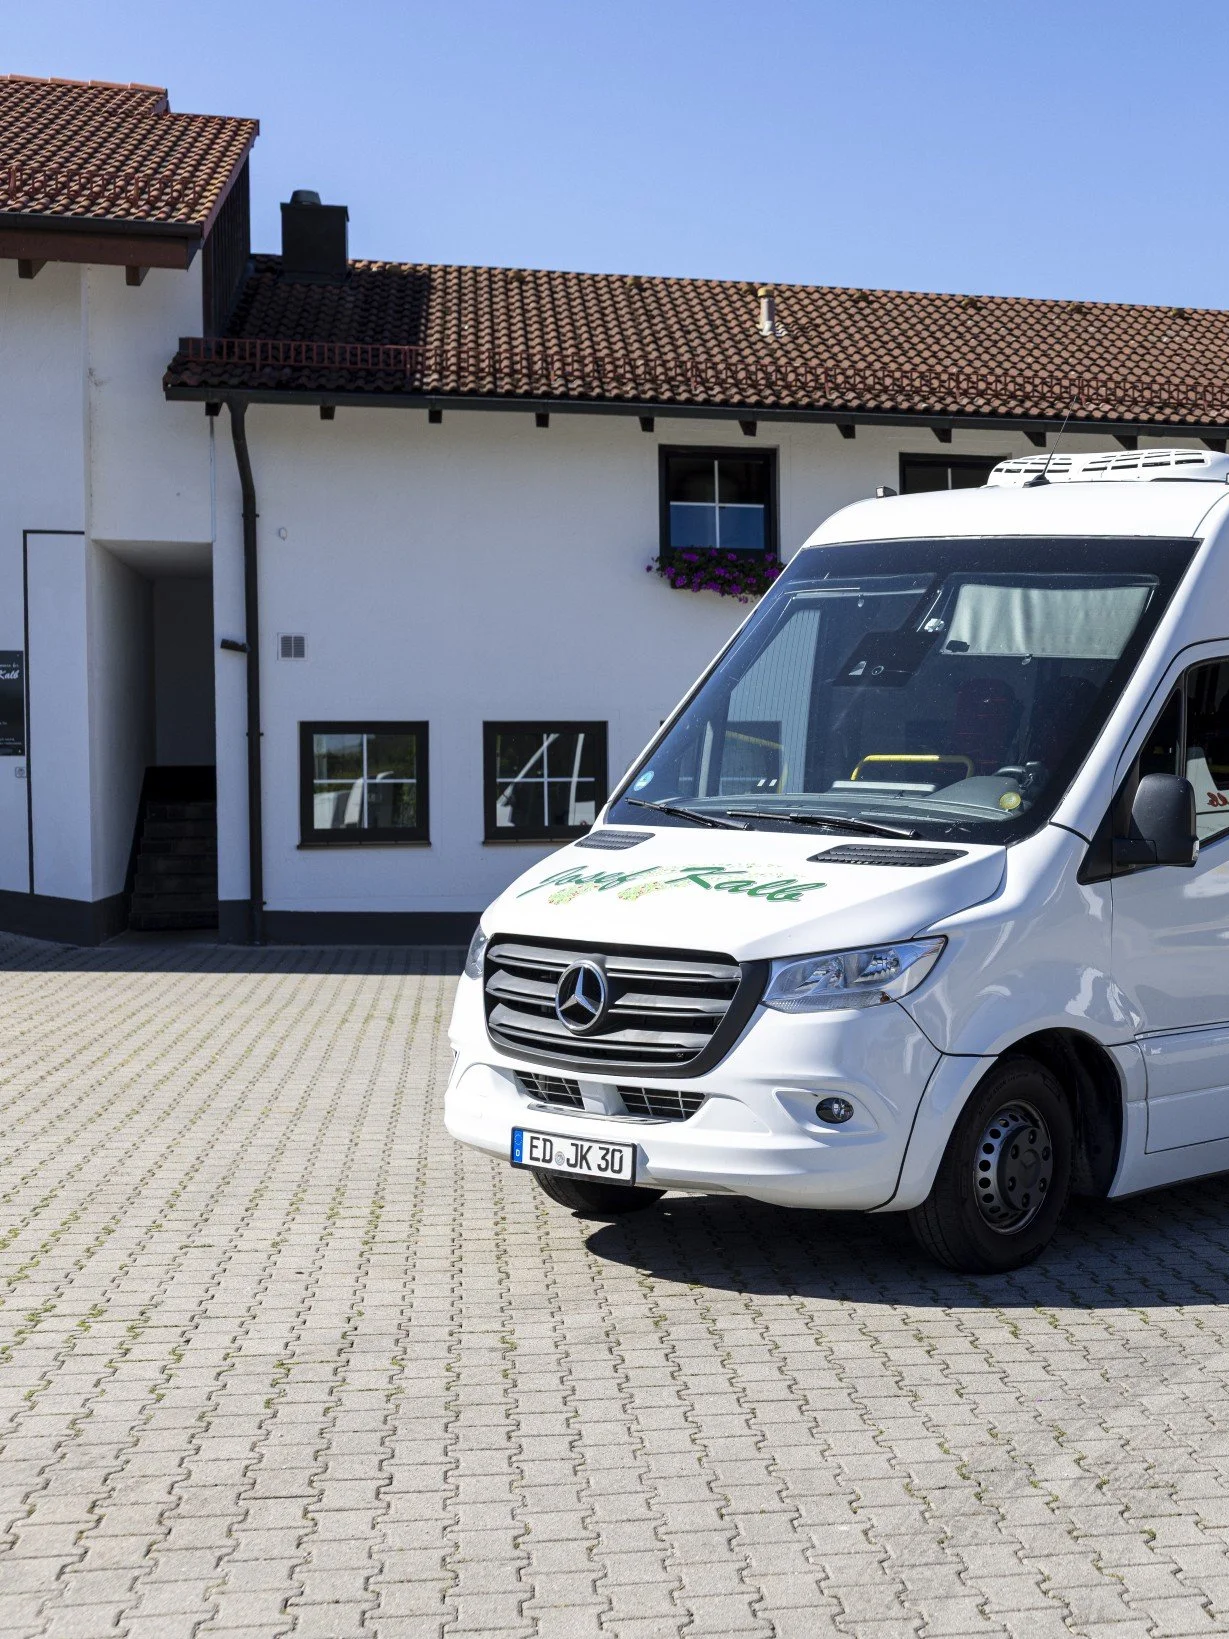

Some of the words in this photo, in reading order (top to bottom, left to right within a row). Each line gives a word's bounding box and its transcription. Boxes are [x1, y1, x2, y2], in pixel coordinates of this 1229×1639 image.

[516, 865, 662, 900] Josef
[664, 866, 828, 902] Kalb
[529, 1135, 554, 1164] ED
[566, 1142, 593, 1171] JK
[597, 1146, 624, 1175] 30
